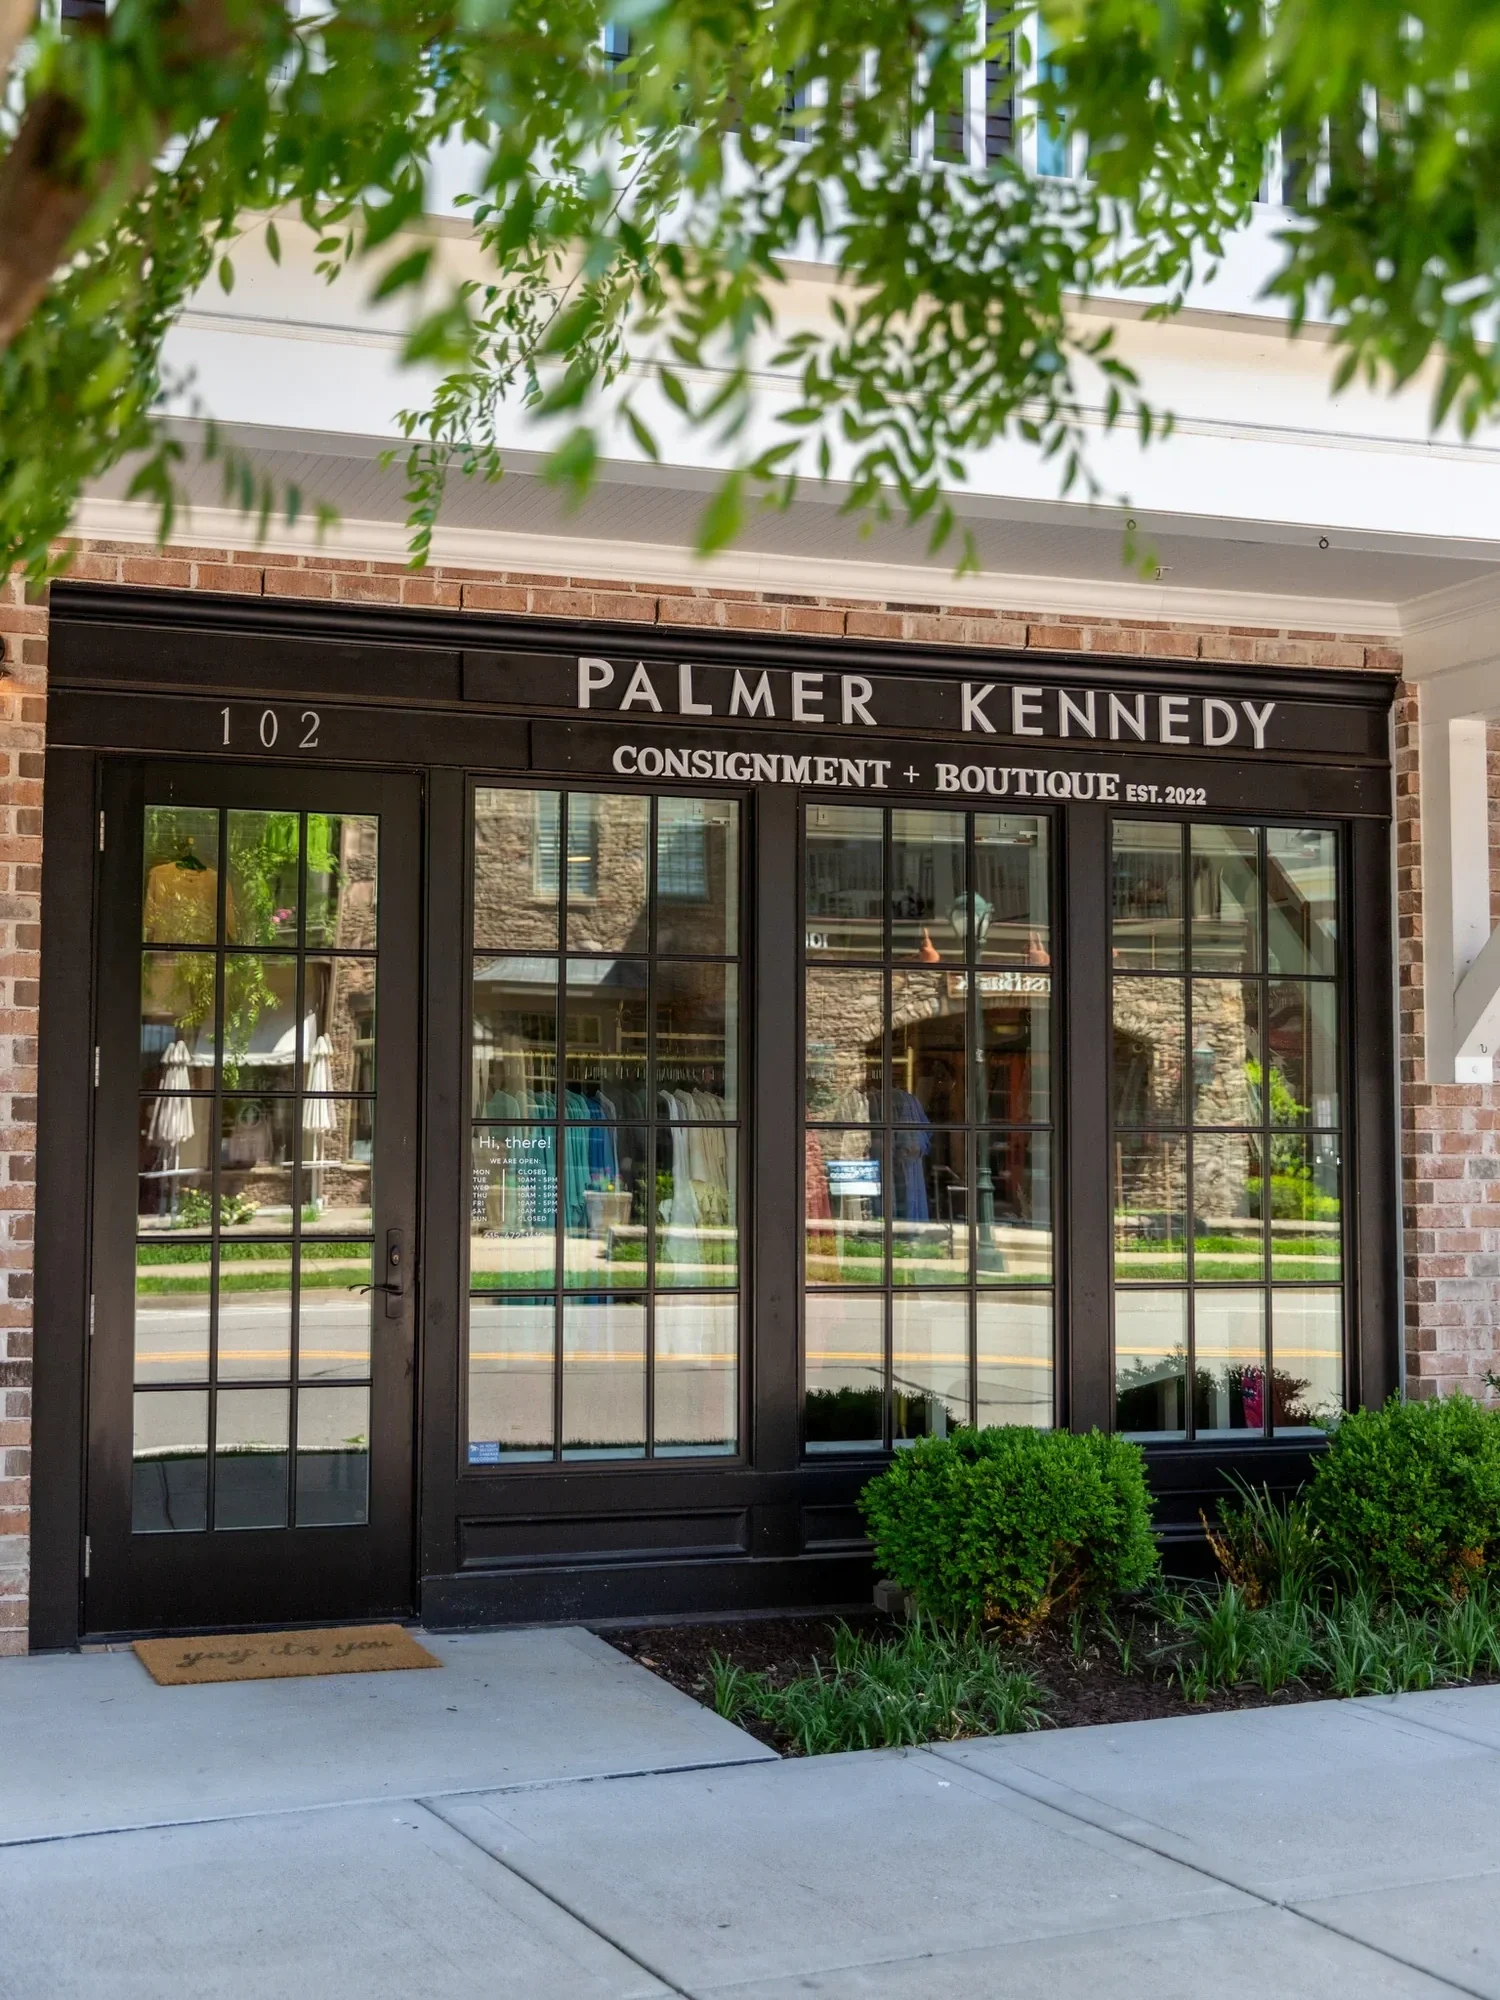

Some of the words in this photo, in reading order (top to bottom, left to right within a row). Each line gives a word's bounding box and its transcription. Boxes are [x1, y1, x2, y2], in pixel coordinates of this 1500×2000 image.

[220, 706, 320, 748] 102
[577, 656, 878, 726] PALMER
[961, 682, 1276, 750] KENNEDY
[612, 745, 891, 789] CONSIGNMENT
[903, 765, 921, 785] +
[935, 763, 1120, 801] BOUTIQUE
[1164, 785, 1207, 806] 2022
[479, 1135, 500, 1150] Hi,
[505, 1135, 551, 1149] there!
